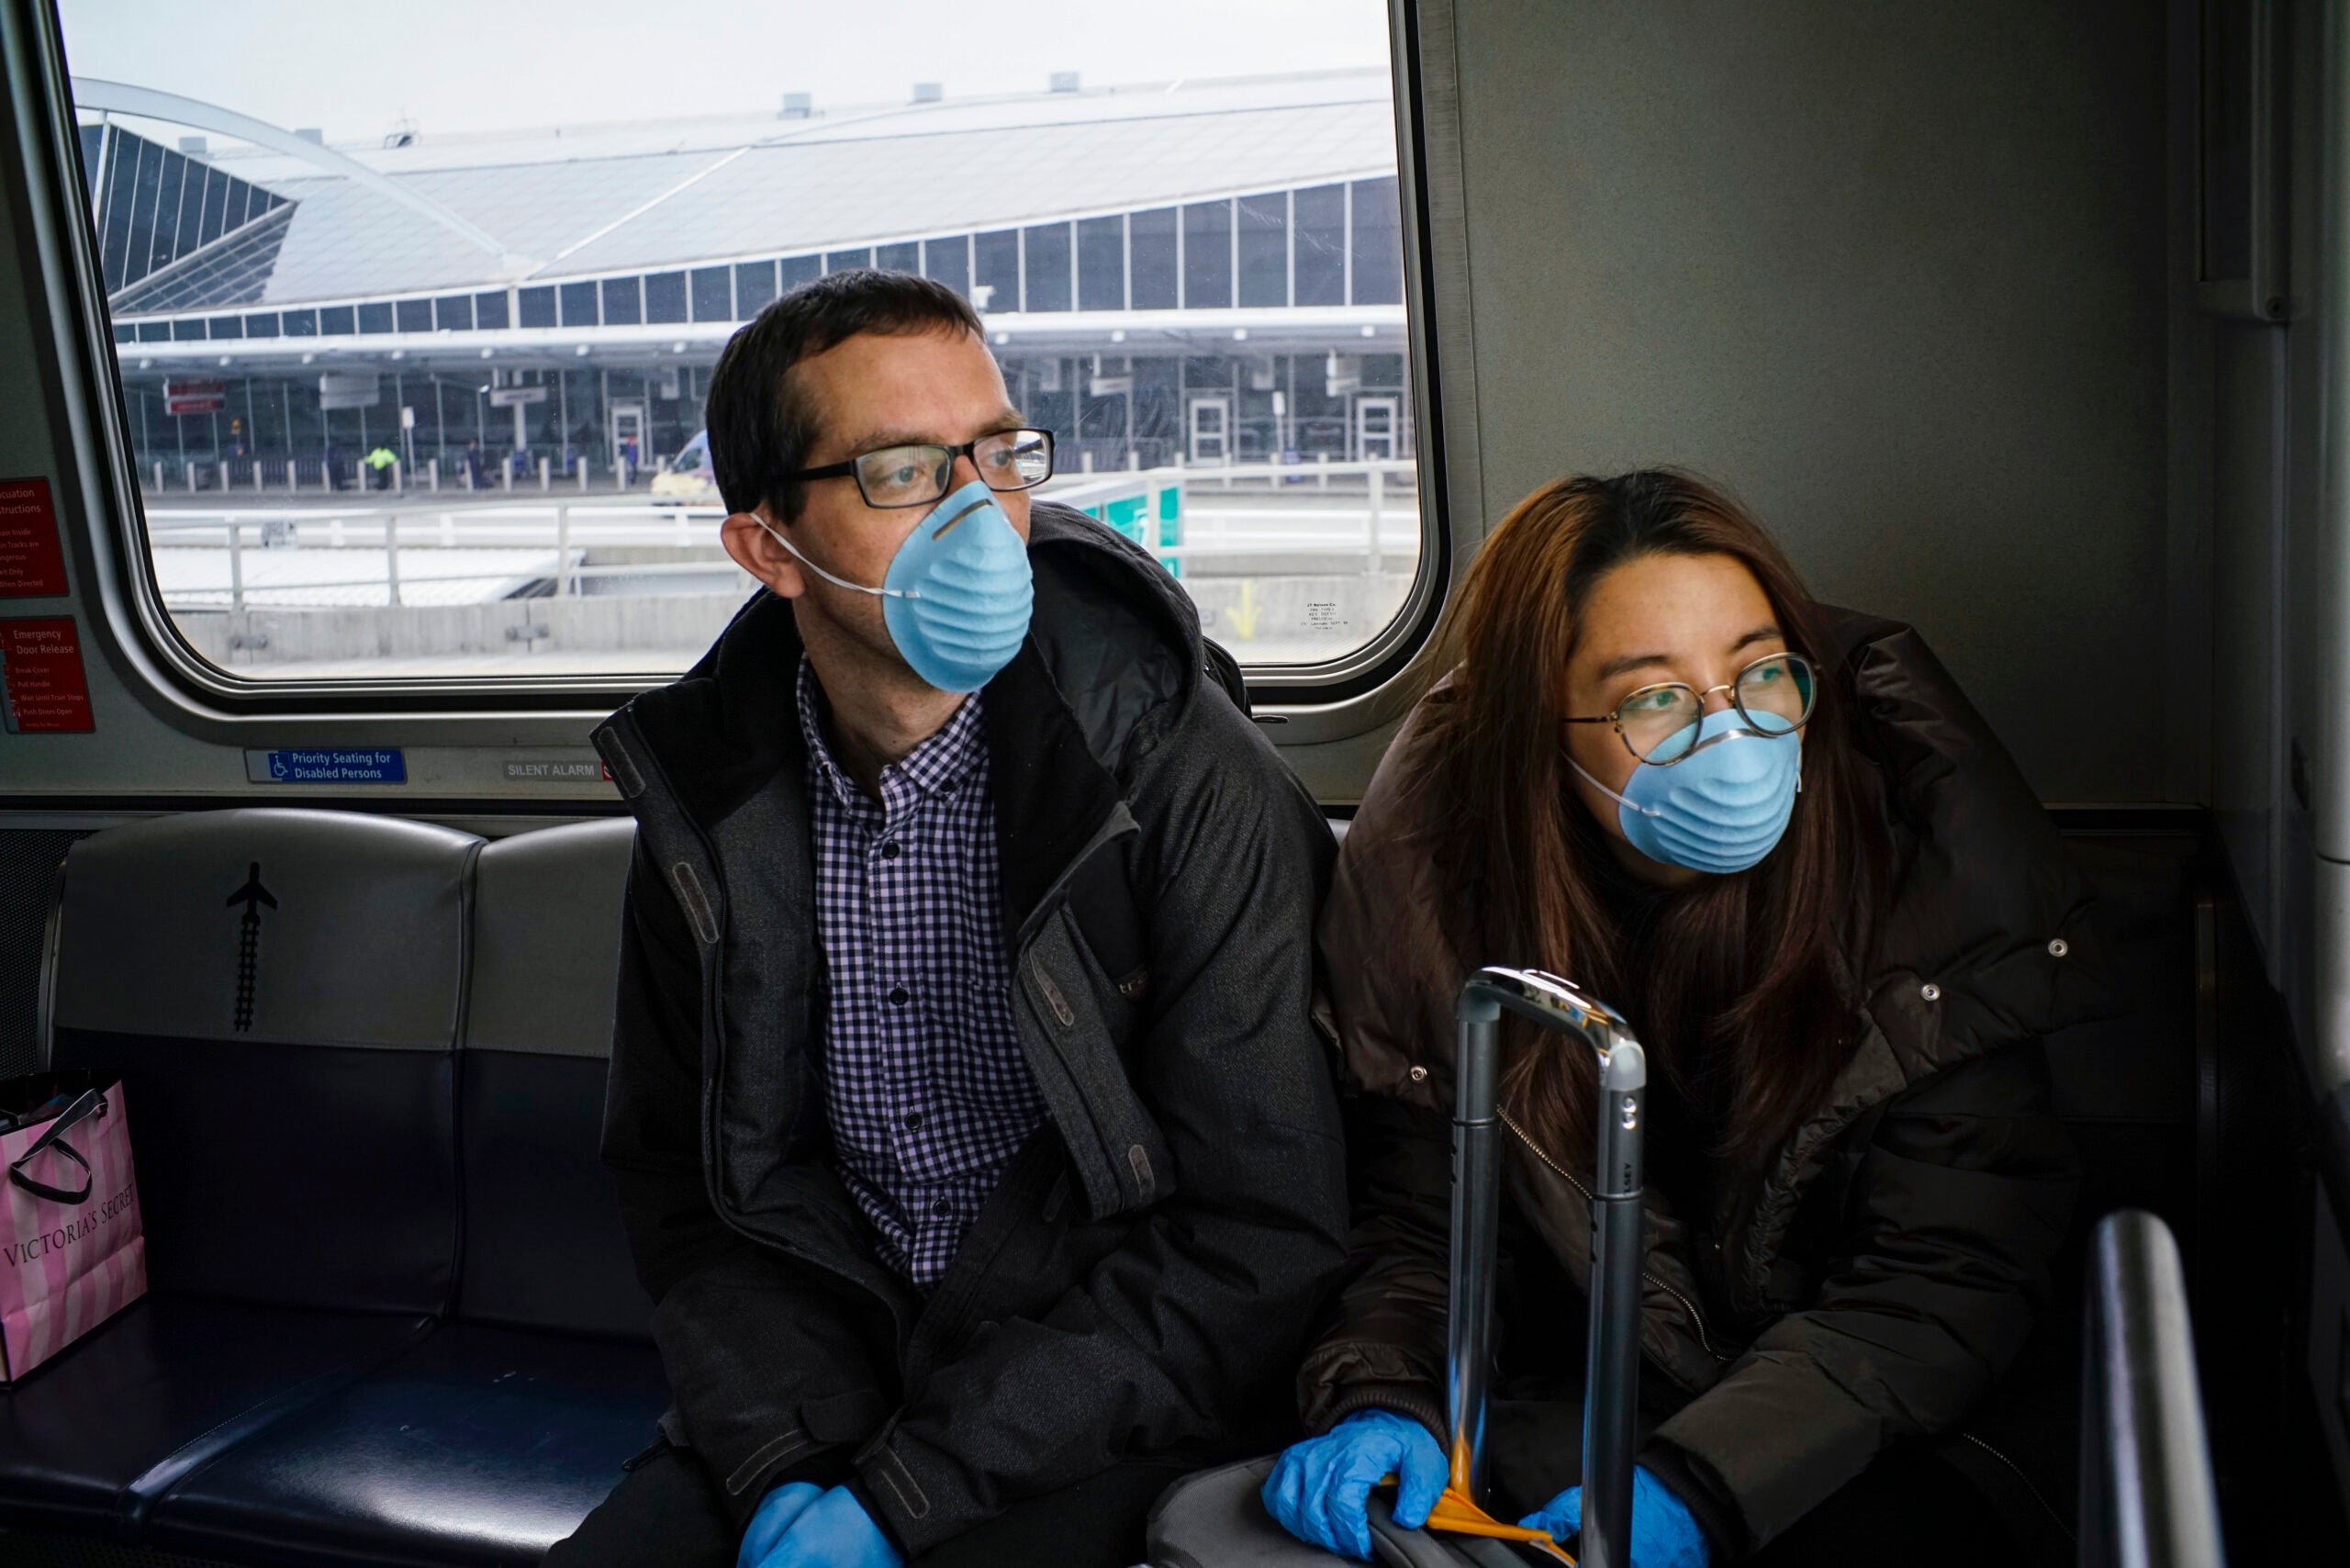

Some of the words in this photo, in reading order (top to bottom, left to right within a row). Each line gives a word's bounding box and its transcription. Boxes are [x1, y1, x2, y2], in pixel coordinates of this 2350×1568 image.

[0, 488, 35, 498] cuation
[13, 630, 62, 641] Emergency
[17, 645, 38, 655] Door
[39, 644, 74, 654] Release
[292, 752, 330, 767] Priority
[333, 752, 372, 767] Seating
[375, 752, 392, 764] for
[295, 767, 339, 779] Disabled
[341, 767, 383, 779] Persons
[508, 764, 550, 777] SILENT
[553, 764, 595, 777] ALARM
[3, 1211, 97, 1268] VICTORIA'S
[101, 1183, 135, 1224] SECRET
